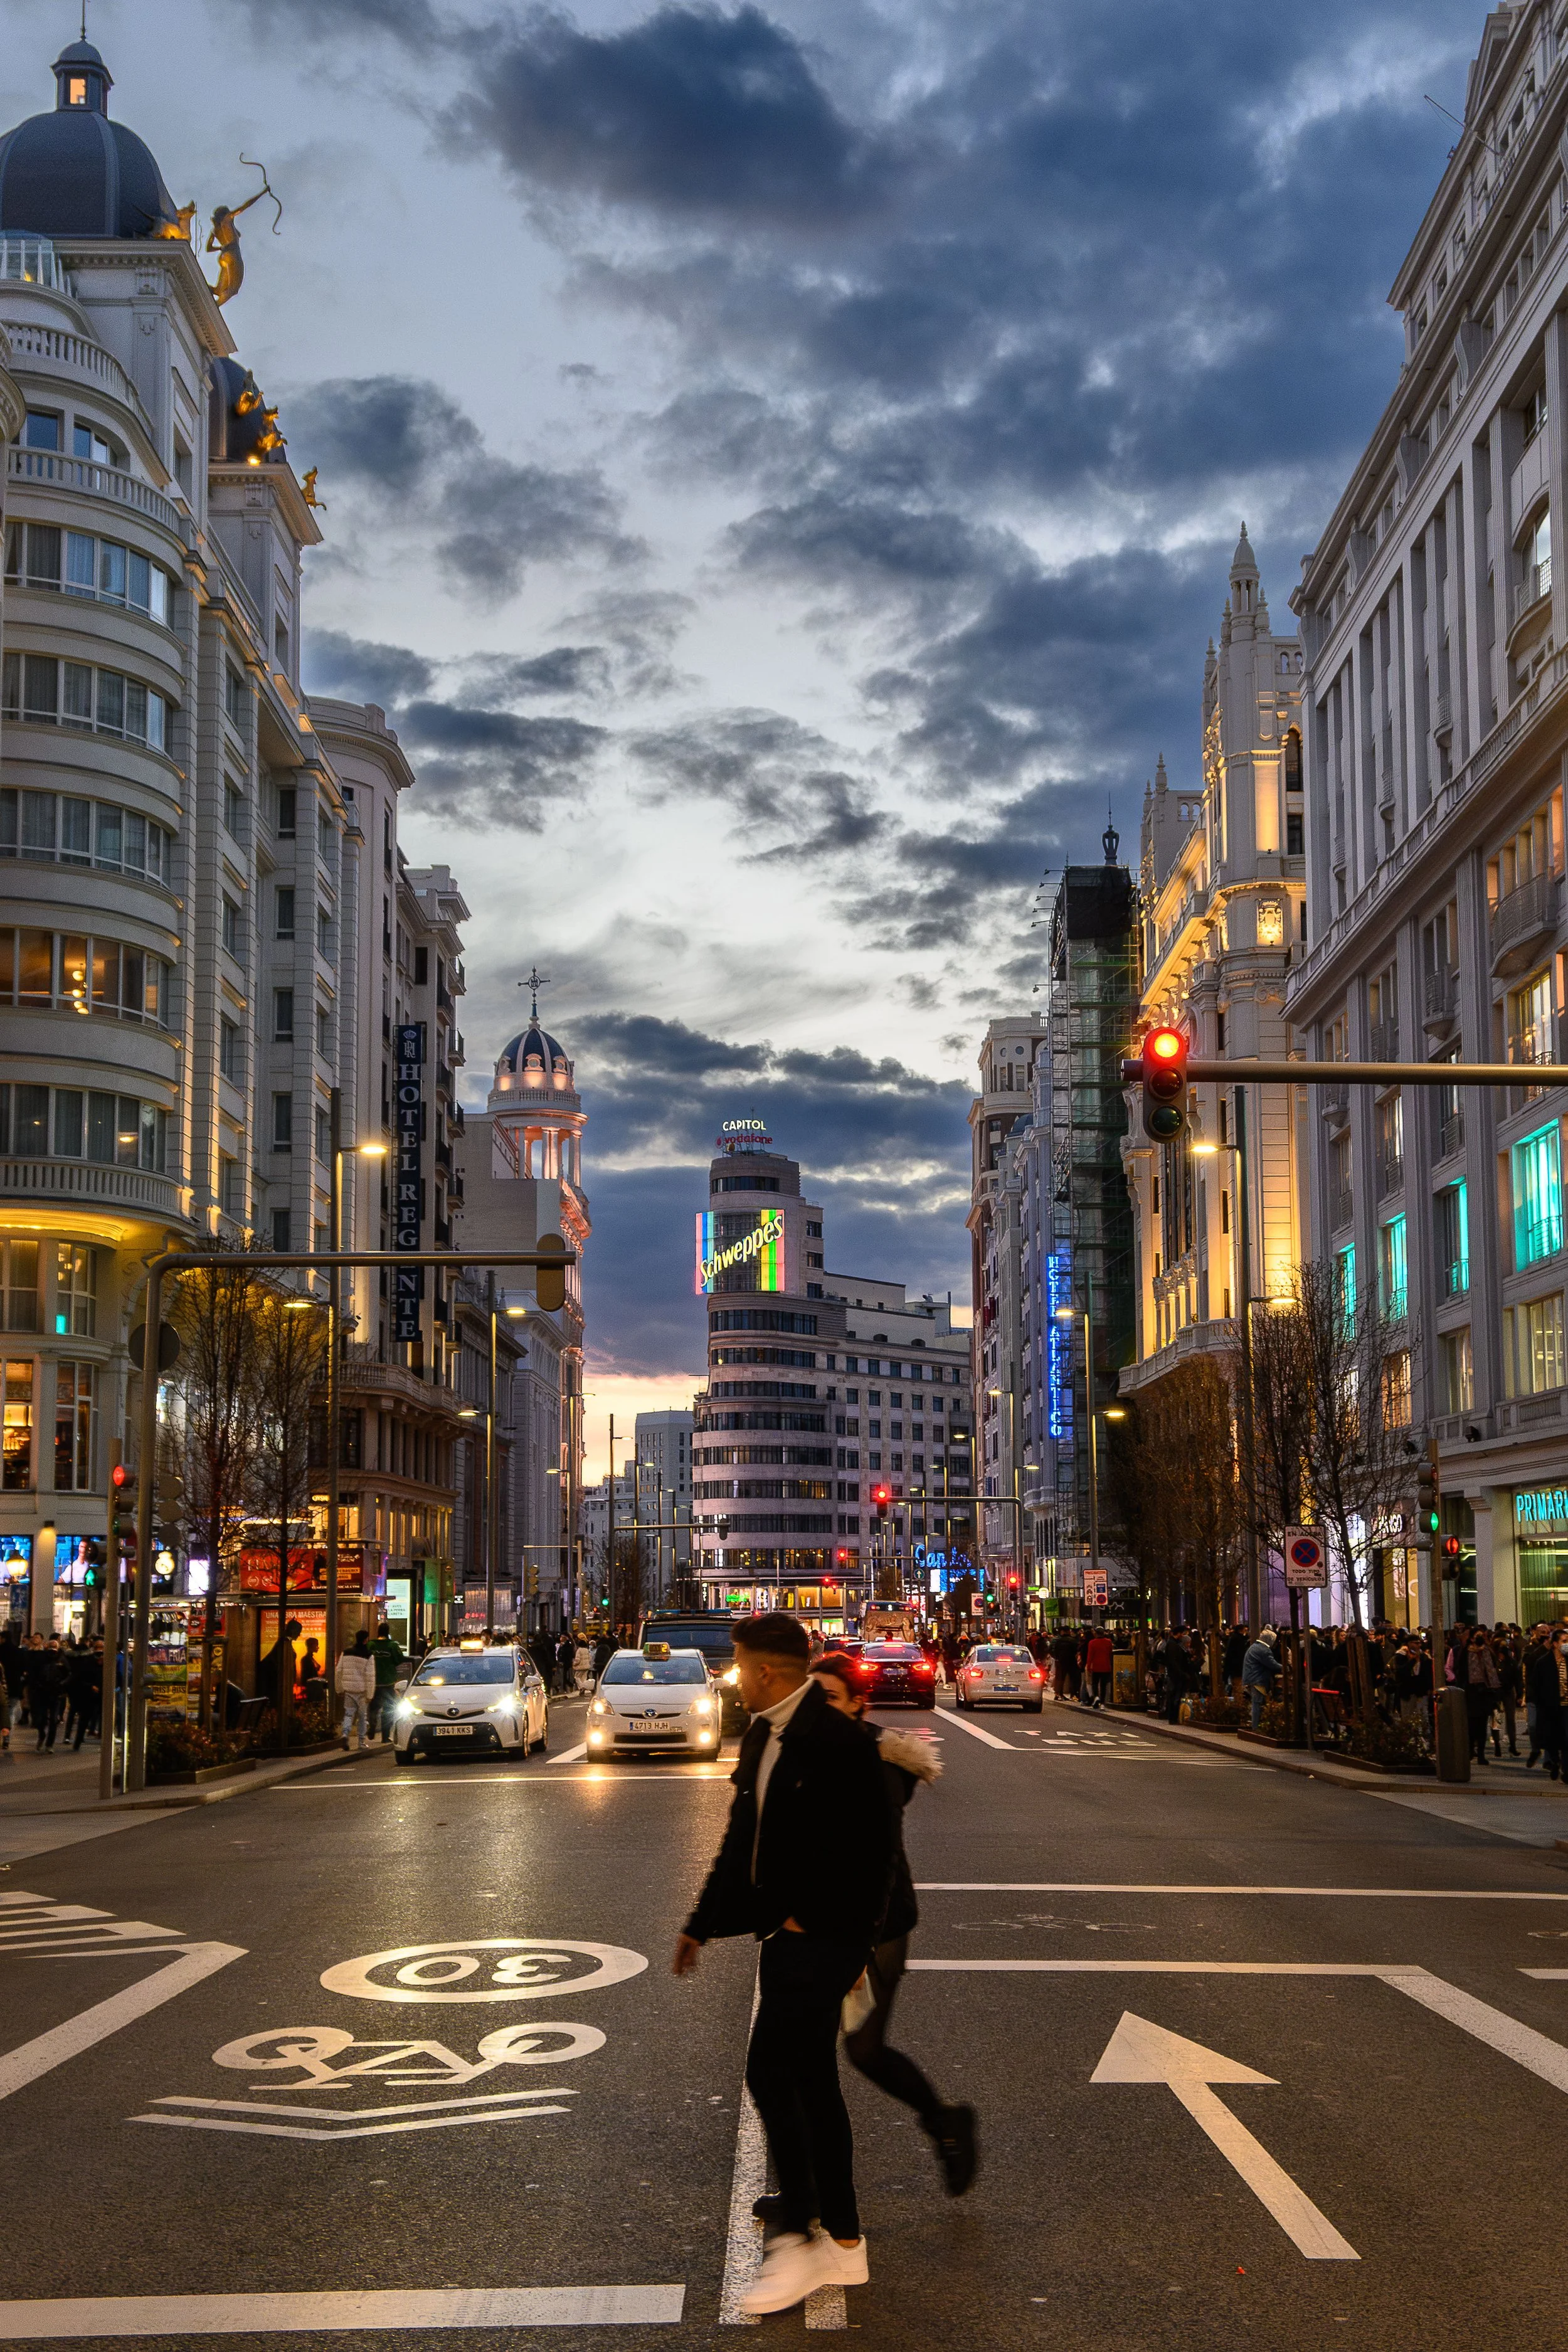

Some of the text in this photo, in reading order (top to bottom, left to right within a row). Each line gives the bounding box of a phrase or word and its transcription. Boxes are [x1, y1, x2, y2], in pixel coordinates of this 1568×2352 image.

[399, 1064, 420, 1170] HOTEL
[723, 1120, 766, 1131] CAPITOL
[725, 1133, 773, 1144] vodafone
[398, 1184, 418, 1337] REGNTE
[700, 1216, 783, 1287] Schweppes
[298, 1611, 326, 1619] MAESTRA
[396, 1954, 572, 1986] 30
